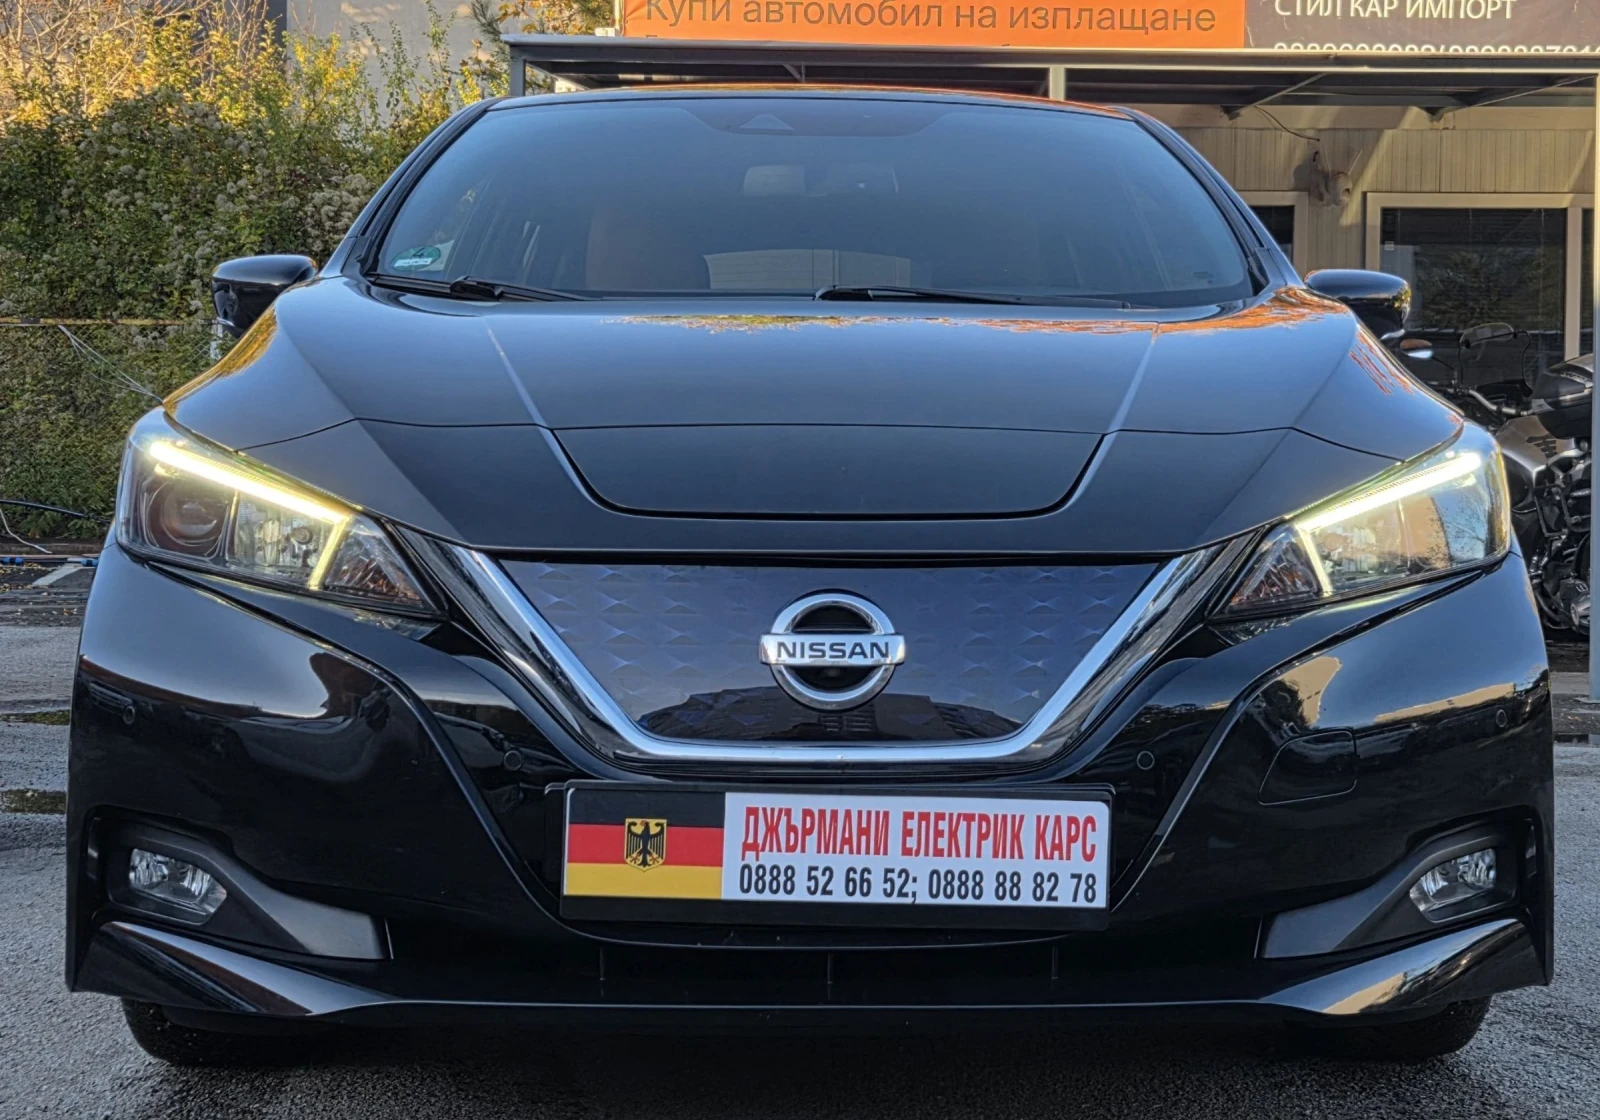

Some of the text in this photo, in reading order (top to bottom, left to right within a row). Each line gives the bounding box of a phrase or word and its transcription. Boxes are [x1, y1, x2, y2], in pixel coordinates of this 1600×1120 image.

[646, 0, 1216, 35] Купи автомобил на изплащане
[1350, 0, 1398, 18] КАР
[1405, 0, 1517, 19] ИМПОРТ
[777, 641, 890, 659] NISSAN
[741, 806, 1097, 862] ДЖЪРМАНИ ЕЛЕКТРИК КАРС
[739, 863, 1097, 905] 0888 52 66 52; 0888 88 82 78
